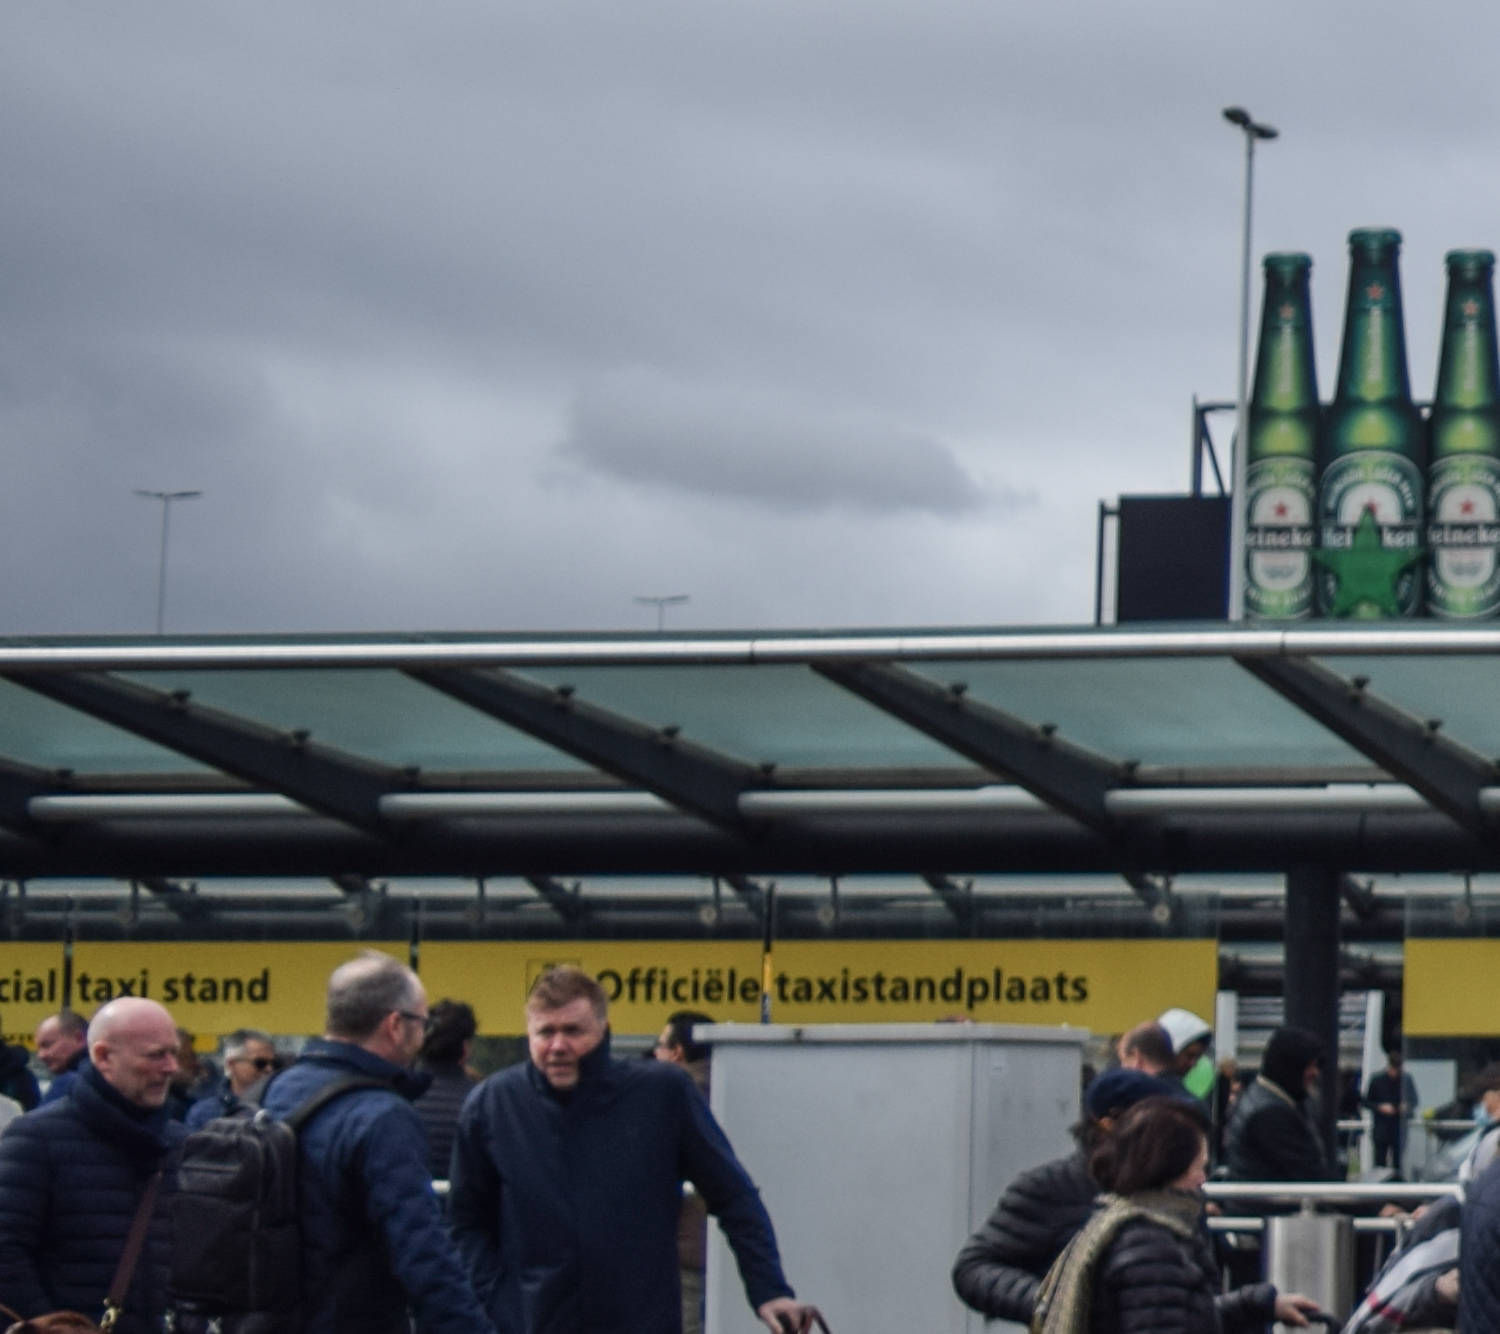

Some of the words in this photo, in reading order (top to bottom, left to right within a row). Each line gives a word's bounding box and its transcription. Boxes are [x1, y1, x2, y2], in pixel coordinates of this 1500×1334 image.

[1321, 526, 1418, 548] Heiken
[78, 969, 149, 1003] taxi
[163, 968, 269, 1003] stand
[598, 968, 761, 1004] Officiële
[775, 968, 1089, 1009] taxistandplaats
